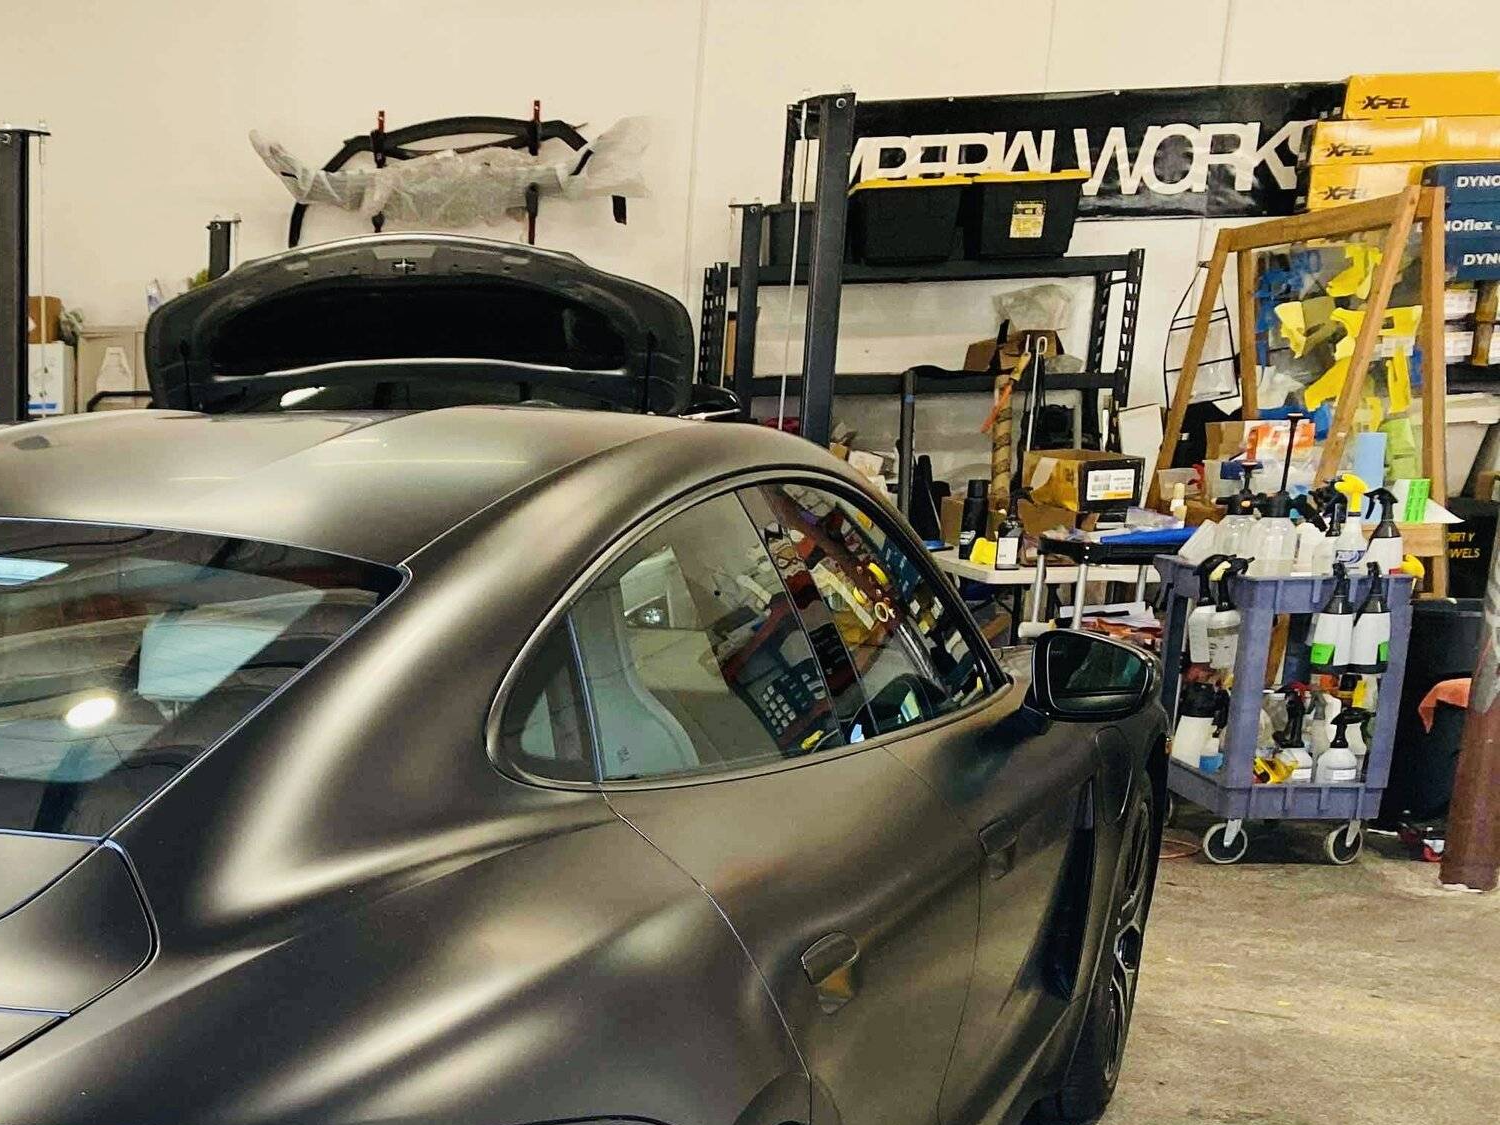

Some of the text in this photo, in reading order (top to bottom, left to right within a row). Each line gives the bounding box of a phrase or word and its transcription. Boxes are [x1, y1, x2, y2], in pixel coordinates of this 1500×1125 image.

[1361, 95, 1410, 110] XPEL
[1325, 143, 1374, 157] XPEL
[1463, 253, 1500, 266] DYN
[1449, 547, 1481, 559] WELS
